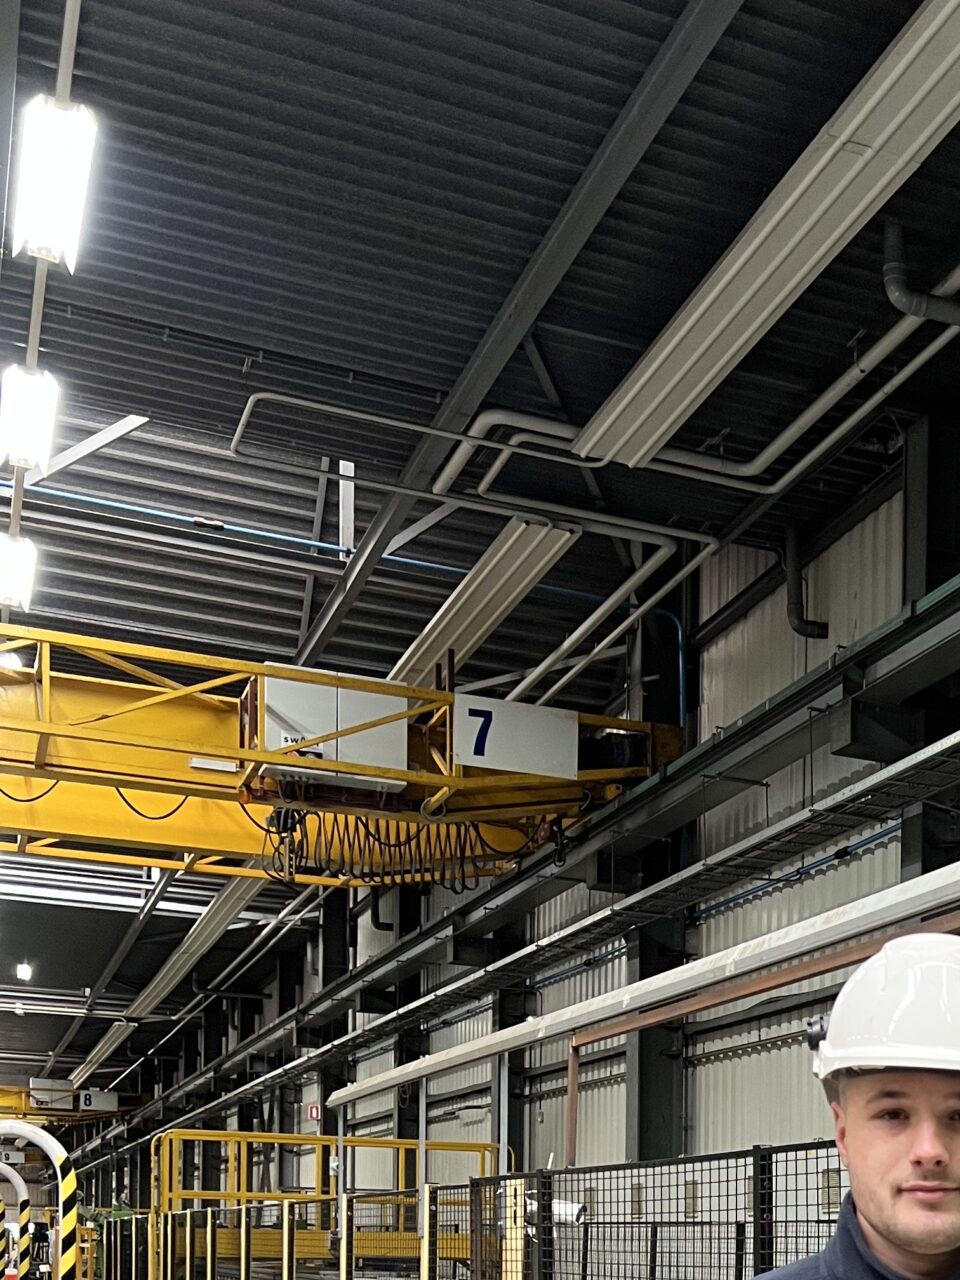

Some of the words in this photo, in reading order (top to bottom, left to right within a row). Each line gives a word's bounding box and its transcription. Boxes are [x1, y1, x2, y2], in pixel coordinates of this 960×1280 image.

[468, 707, 493, 756] 7
[84, 1093, 92, 1107] 8
[4, 1152, 10, 1161] 9
